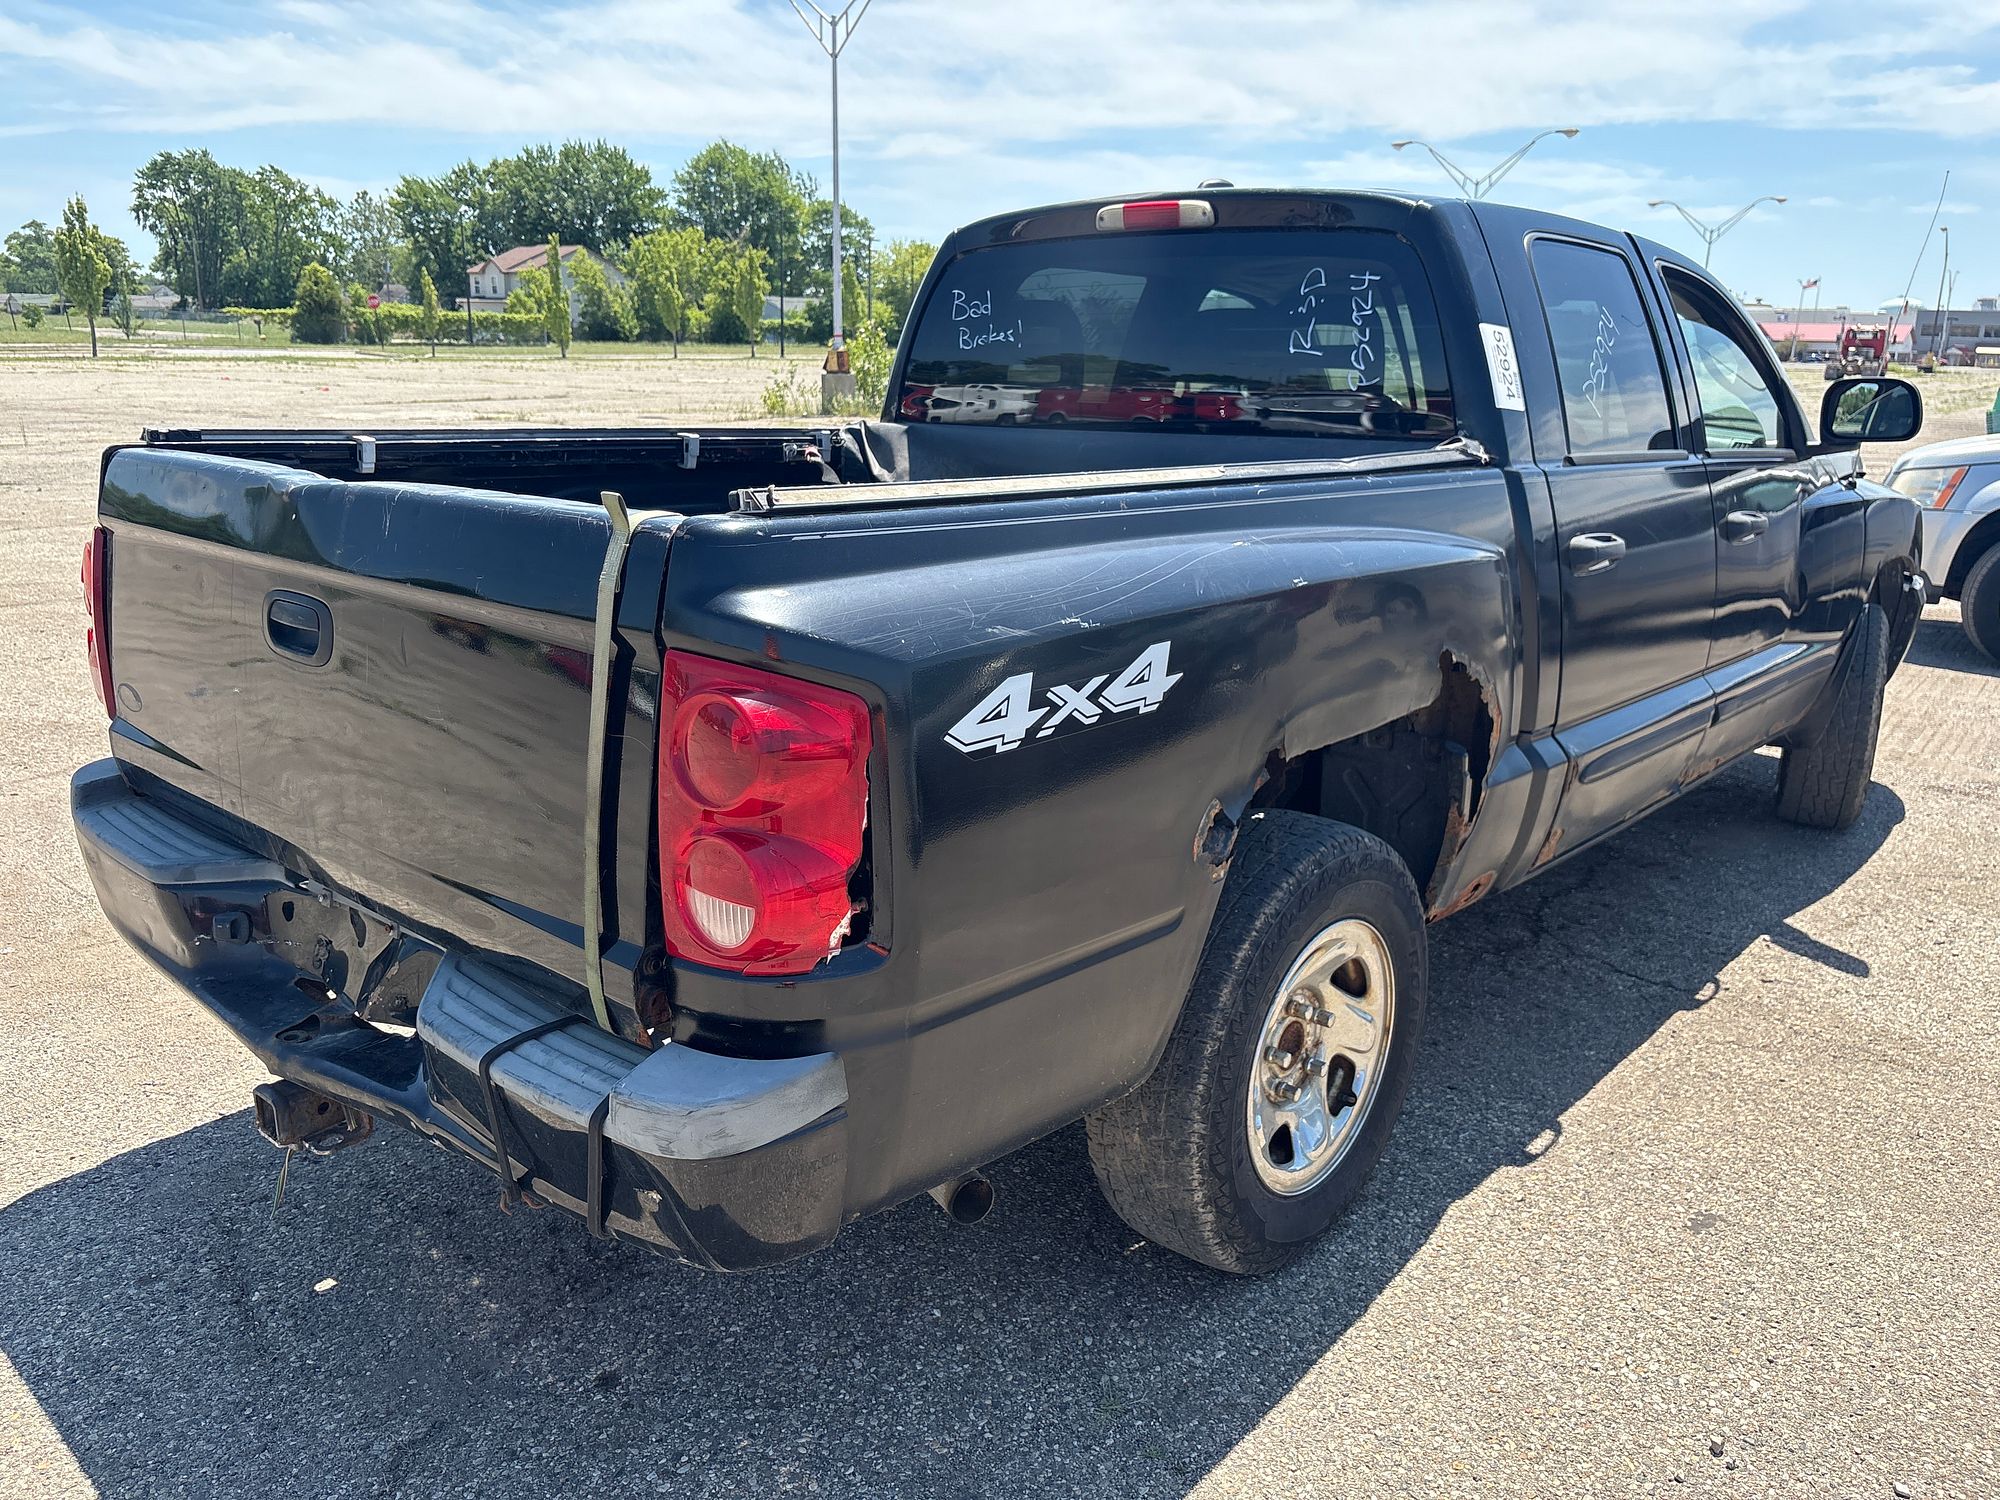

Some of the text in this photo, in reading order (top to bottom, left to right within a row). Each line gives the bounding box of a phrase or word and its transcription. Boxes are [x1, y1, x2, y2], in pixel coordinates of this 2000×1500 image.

[952, 289, 991, 320] Bad
[959, 319, 1022, 349] Brakes!
[1493, 330, 1515, 400] 52924
[943, 641, 1184, 753] 4x4
